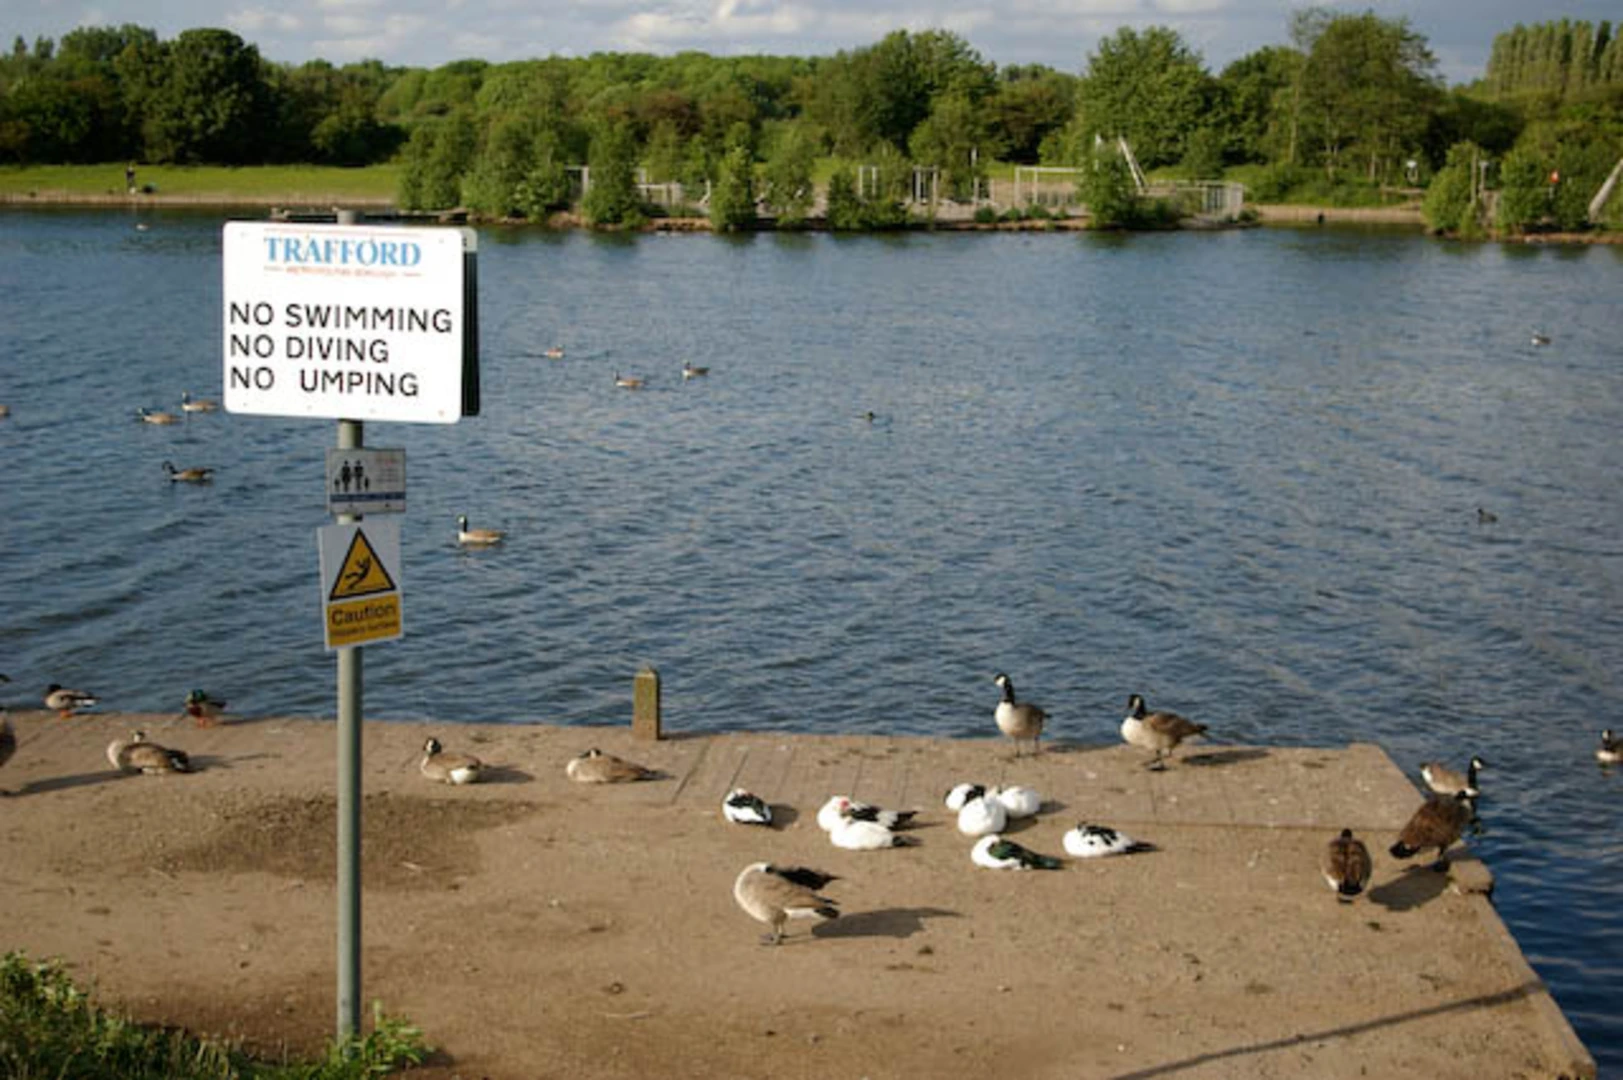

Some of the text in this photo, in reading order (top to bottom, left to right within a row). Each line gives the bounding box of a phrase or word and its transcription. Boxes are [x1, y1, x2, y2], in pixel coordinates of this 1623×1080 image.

[264, 236, 422, 266] TRAFFORD
[230, 301, 452, 333] NO SWIMMING
[230, 333, 389, 363] NO DIVING
[230, 366, 274, 391] NO
[332, 602, 396, 625] Caution
